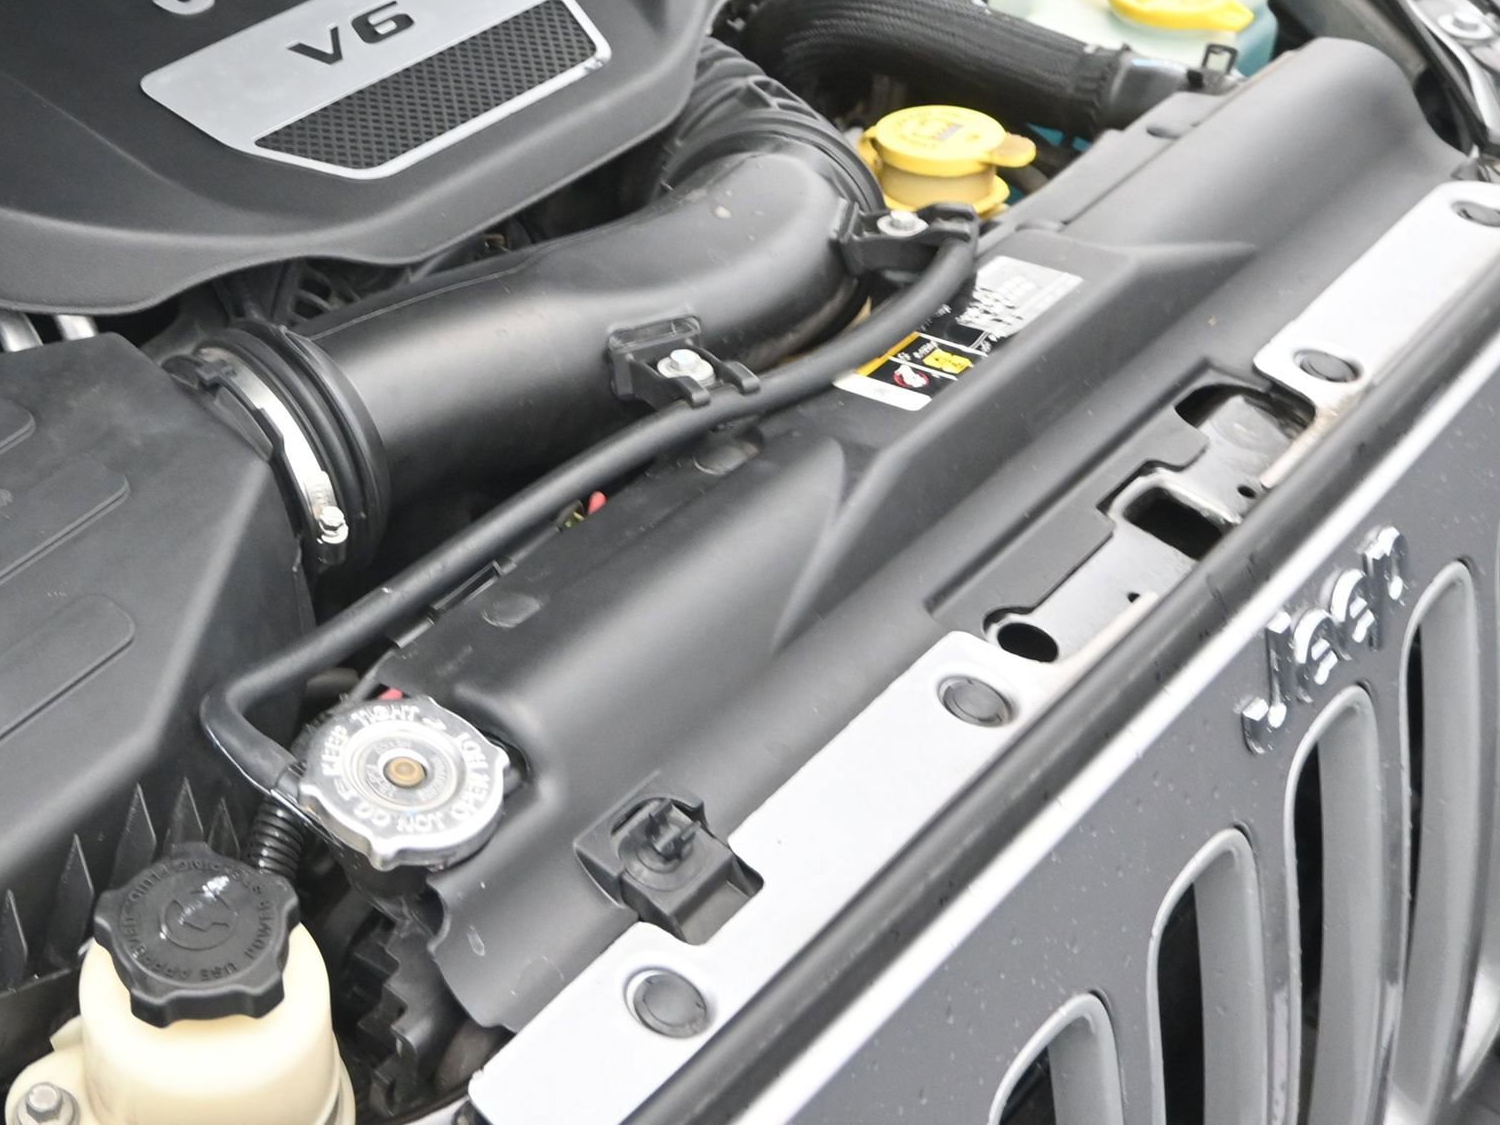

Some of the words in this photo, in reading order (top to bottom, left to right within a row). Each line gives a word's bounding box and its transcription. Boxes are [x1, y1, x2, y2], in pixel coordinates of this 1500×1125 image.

[287, 0, 415, 65] V6
[1241, 526, 1408, 755] Jeep
[321, 725, 349, 777] KEEP
[350, 704, 420, 727] TIGHT
[457, 732, 488, 768] HOT
[354, 804, 391, 828] DO
[451, 774, 491, 819] OPEN
[397, 812, 443, 833] NOT
[245, 901, 274, 959] POWER
